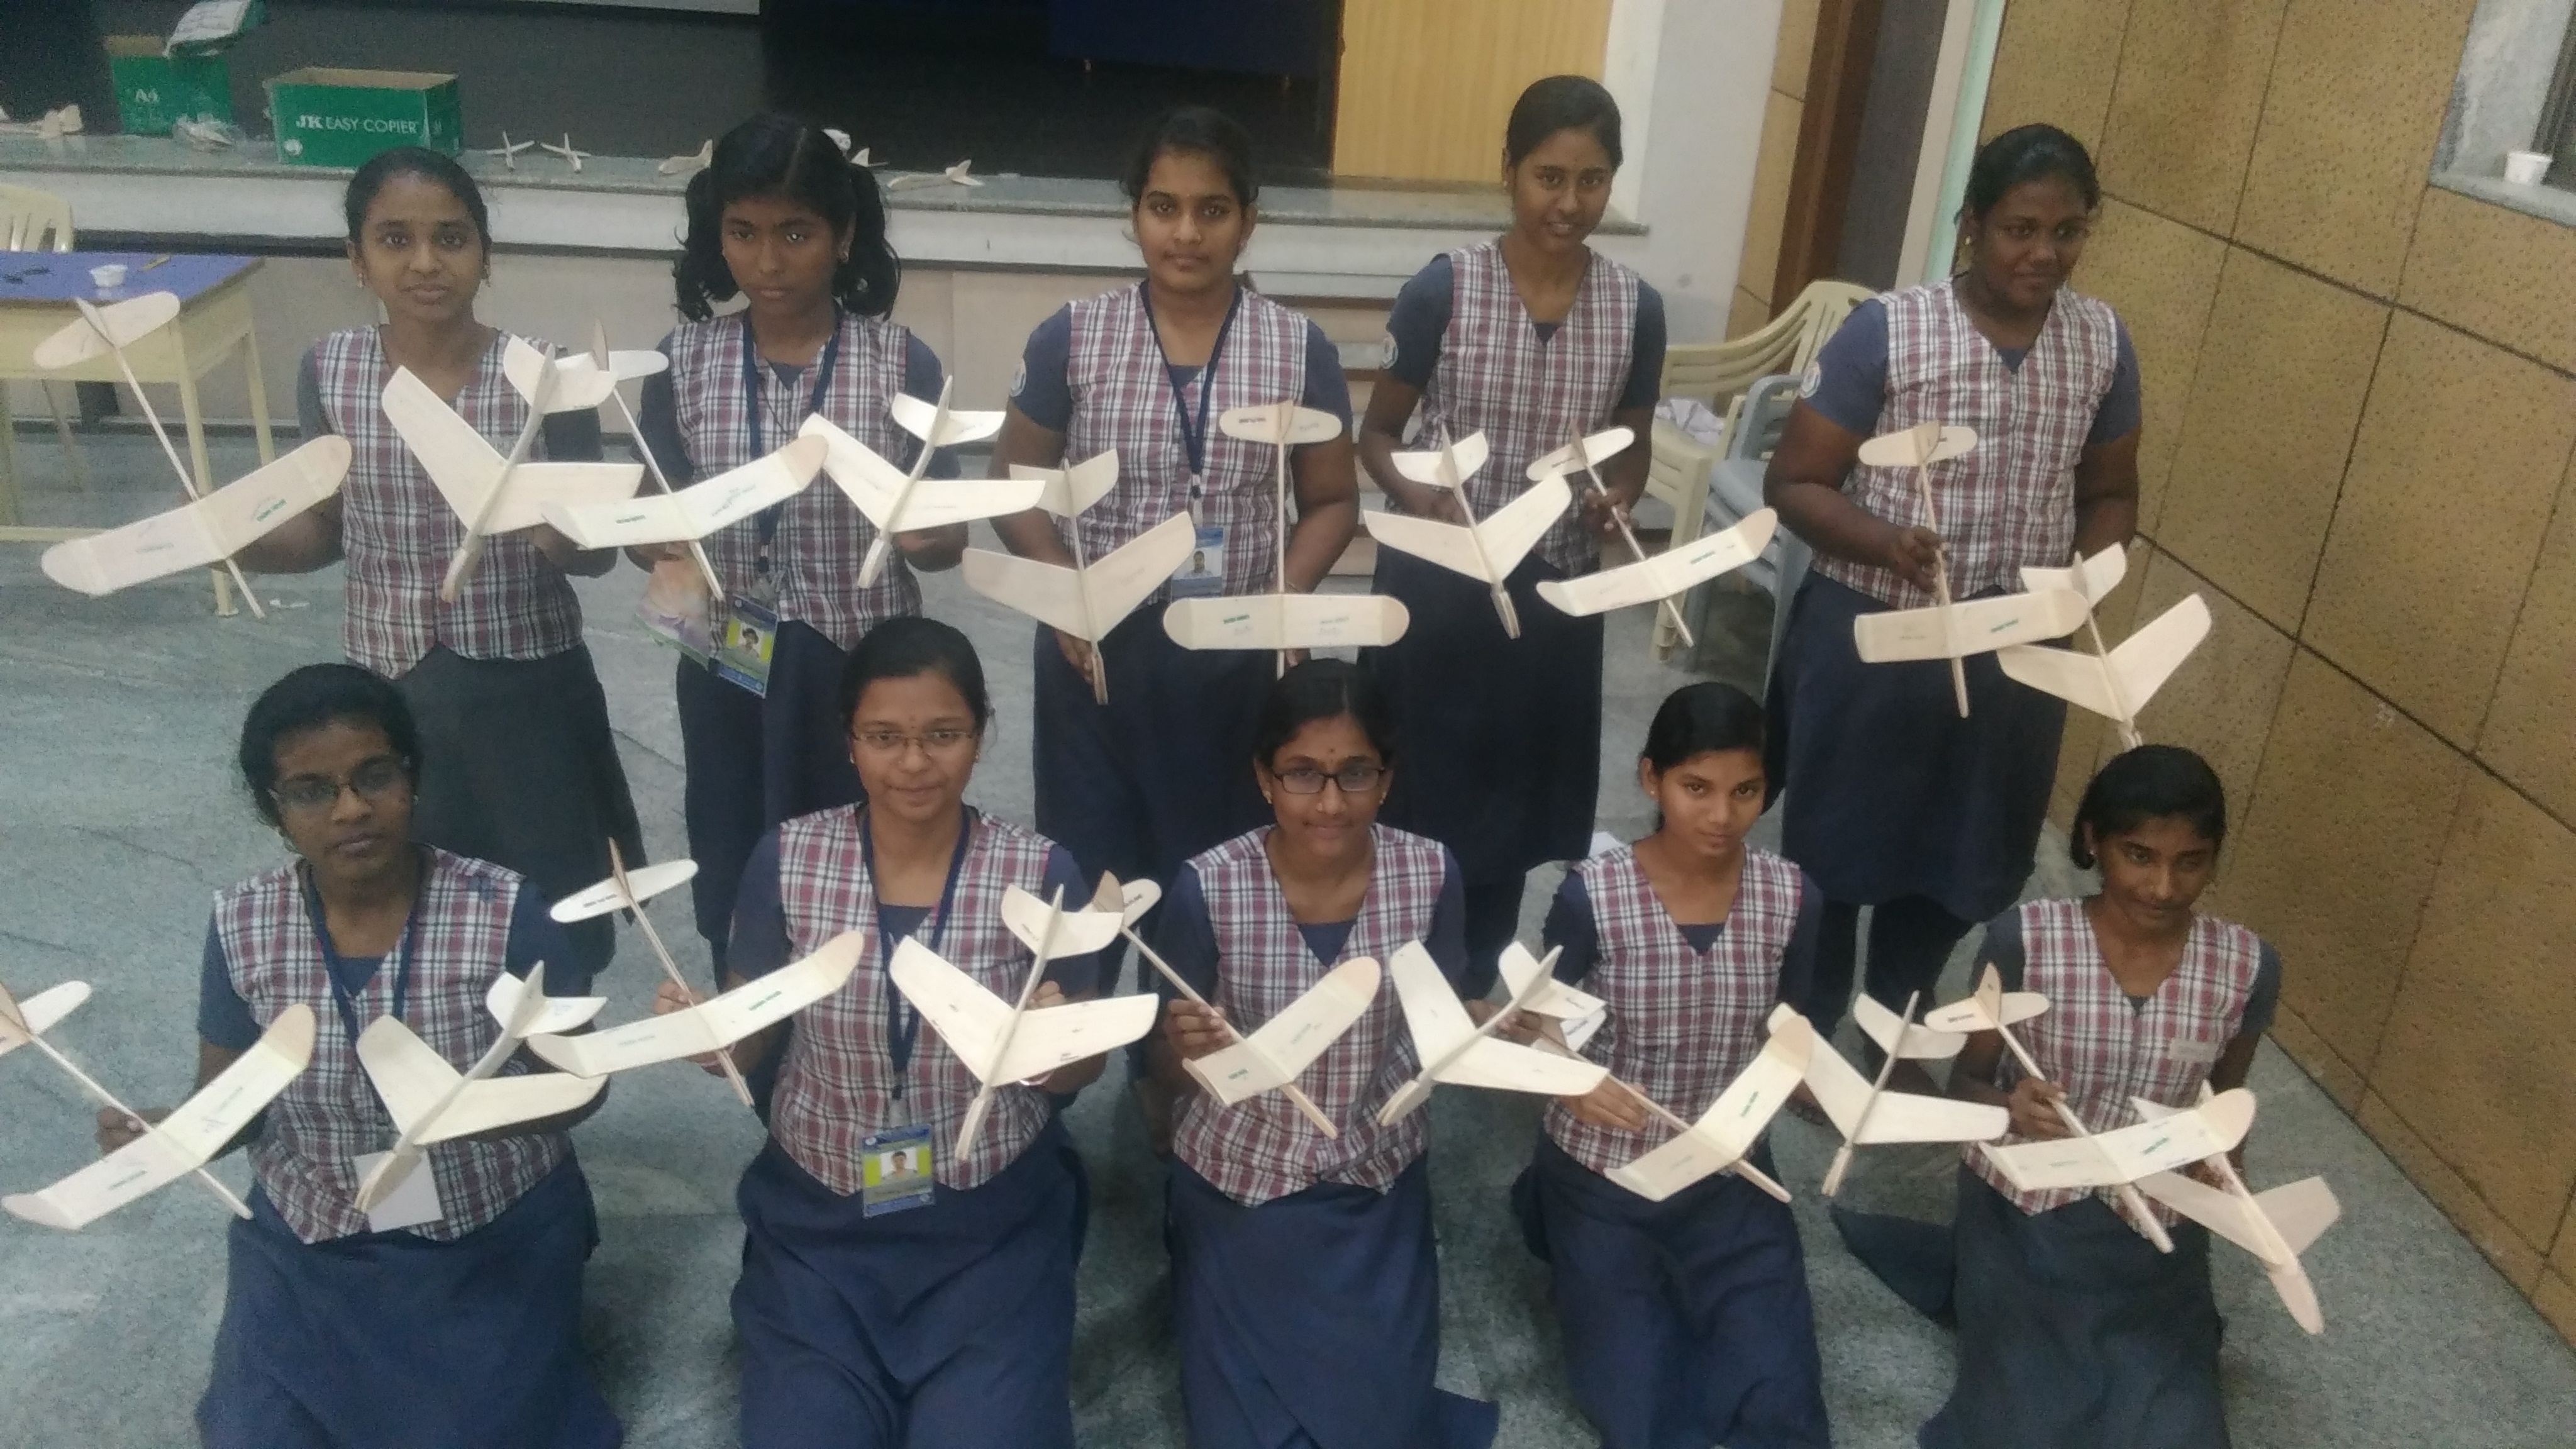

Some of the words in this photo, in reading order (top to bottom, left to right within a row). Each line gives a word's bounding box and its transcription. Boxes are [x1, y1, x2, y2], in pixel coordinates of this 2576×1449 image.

[296, 114, 323, 130] JK
[325, 116, 359, 131] EASY
[363, 119, 418, 134] COPIER
